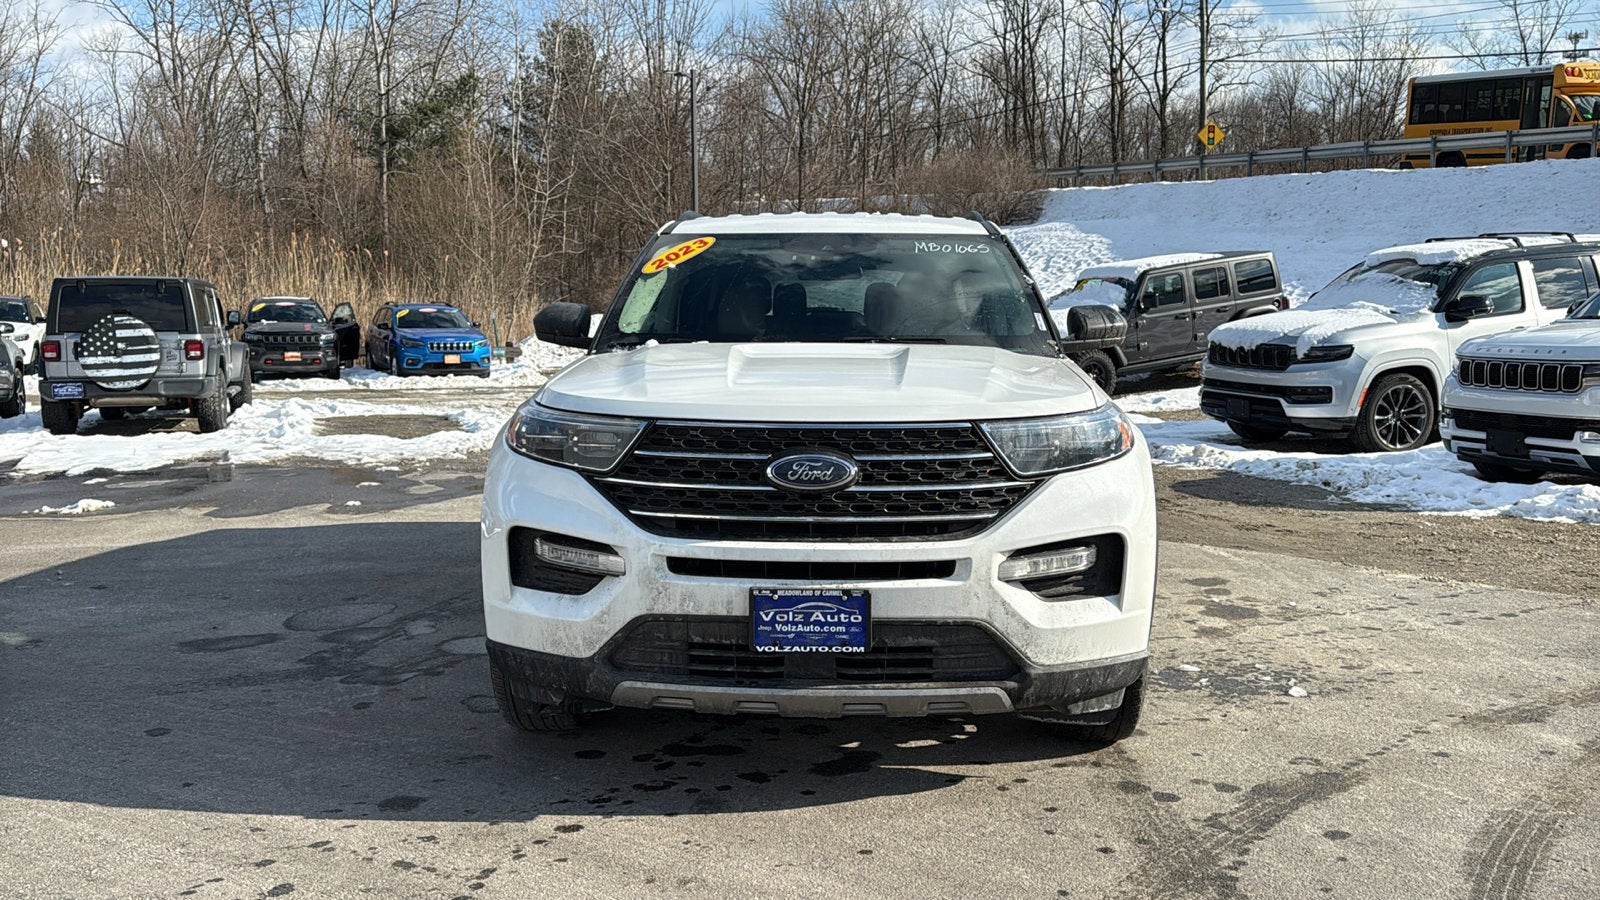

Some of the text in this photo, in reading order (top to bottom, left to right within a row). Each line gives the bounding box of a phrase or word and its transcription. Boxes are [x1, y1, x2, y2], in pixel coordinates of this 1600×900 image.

[651, 239, 709, 270] 2023
[787, 461, 834, 481] Ford
[759, 611, 862, 622] Volz Auto
[775, 623, 846, 632] VolzAuto.com
